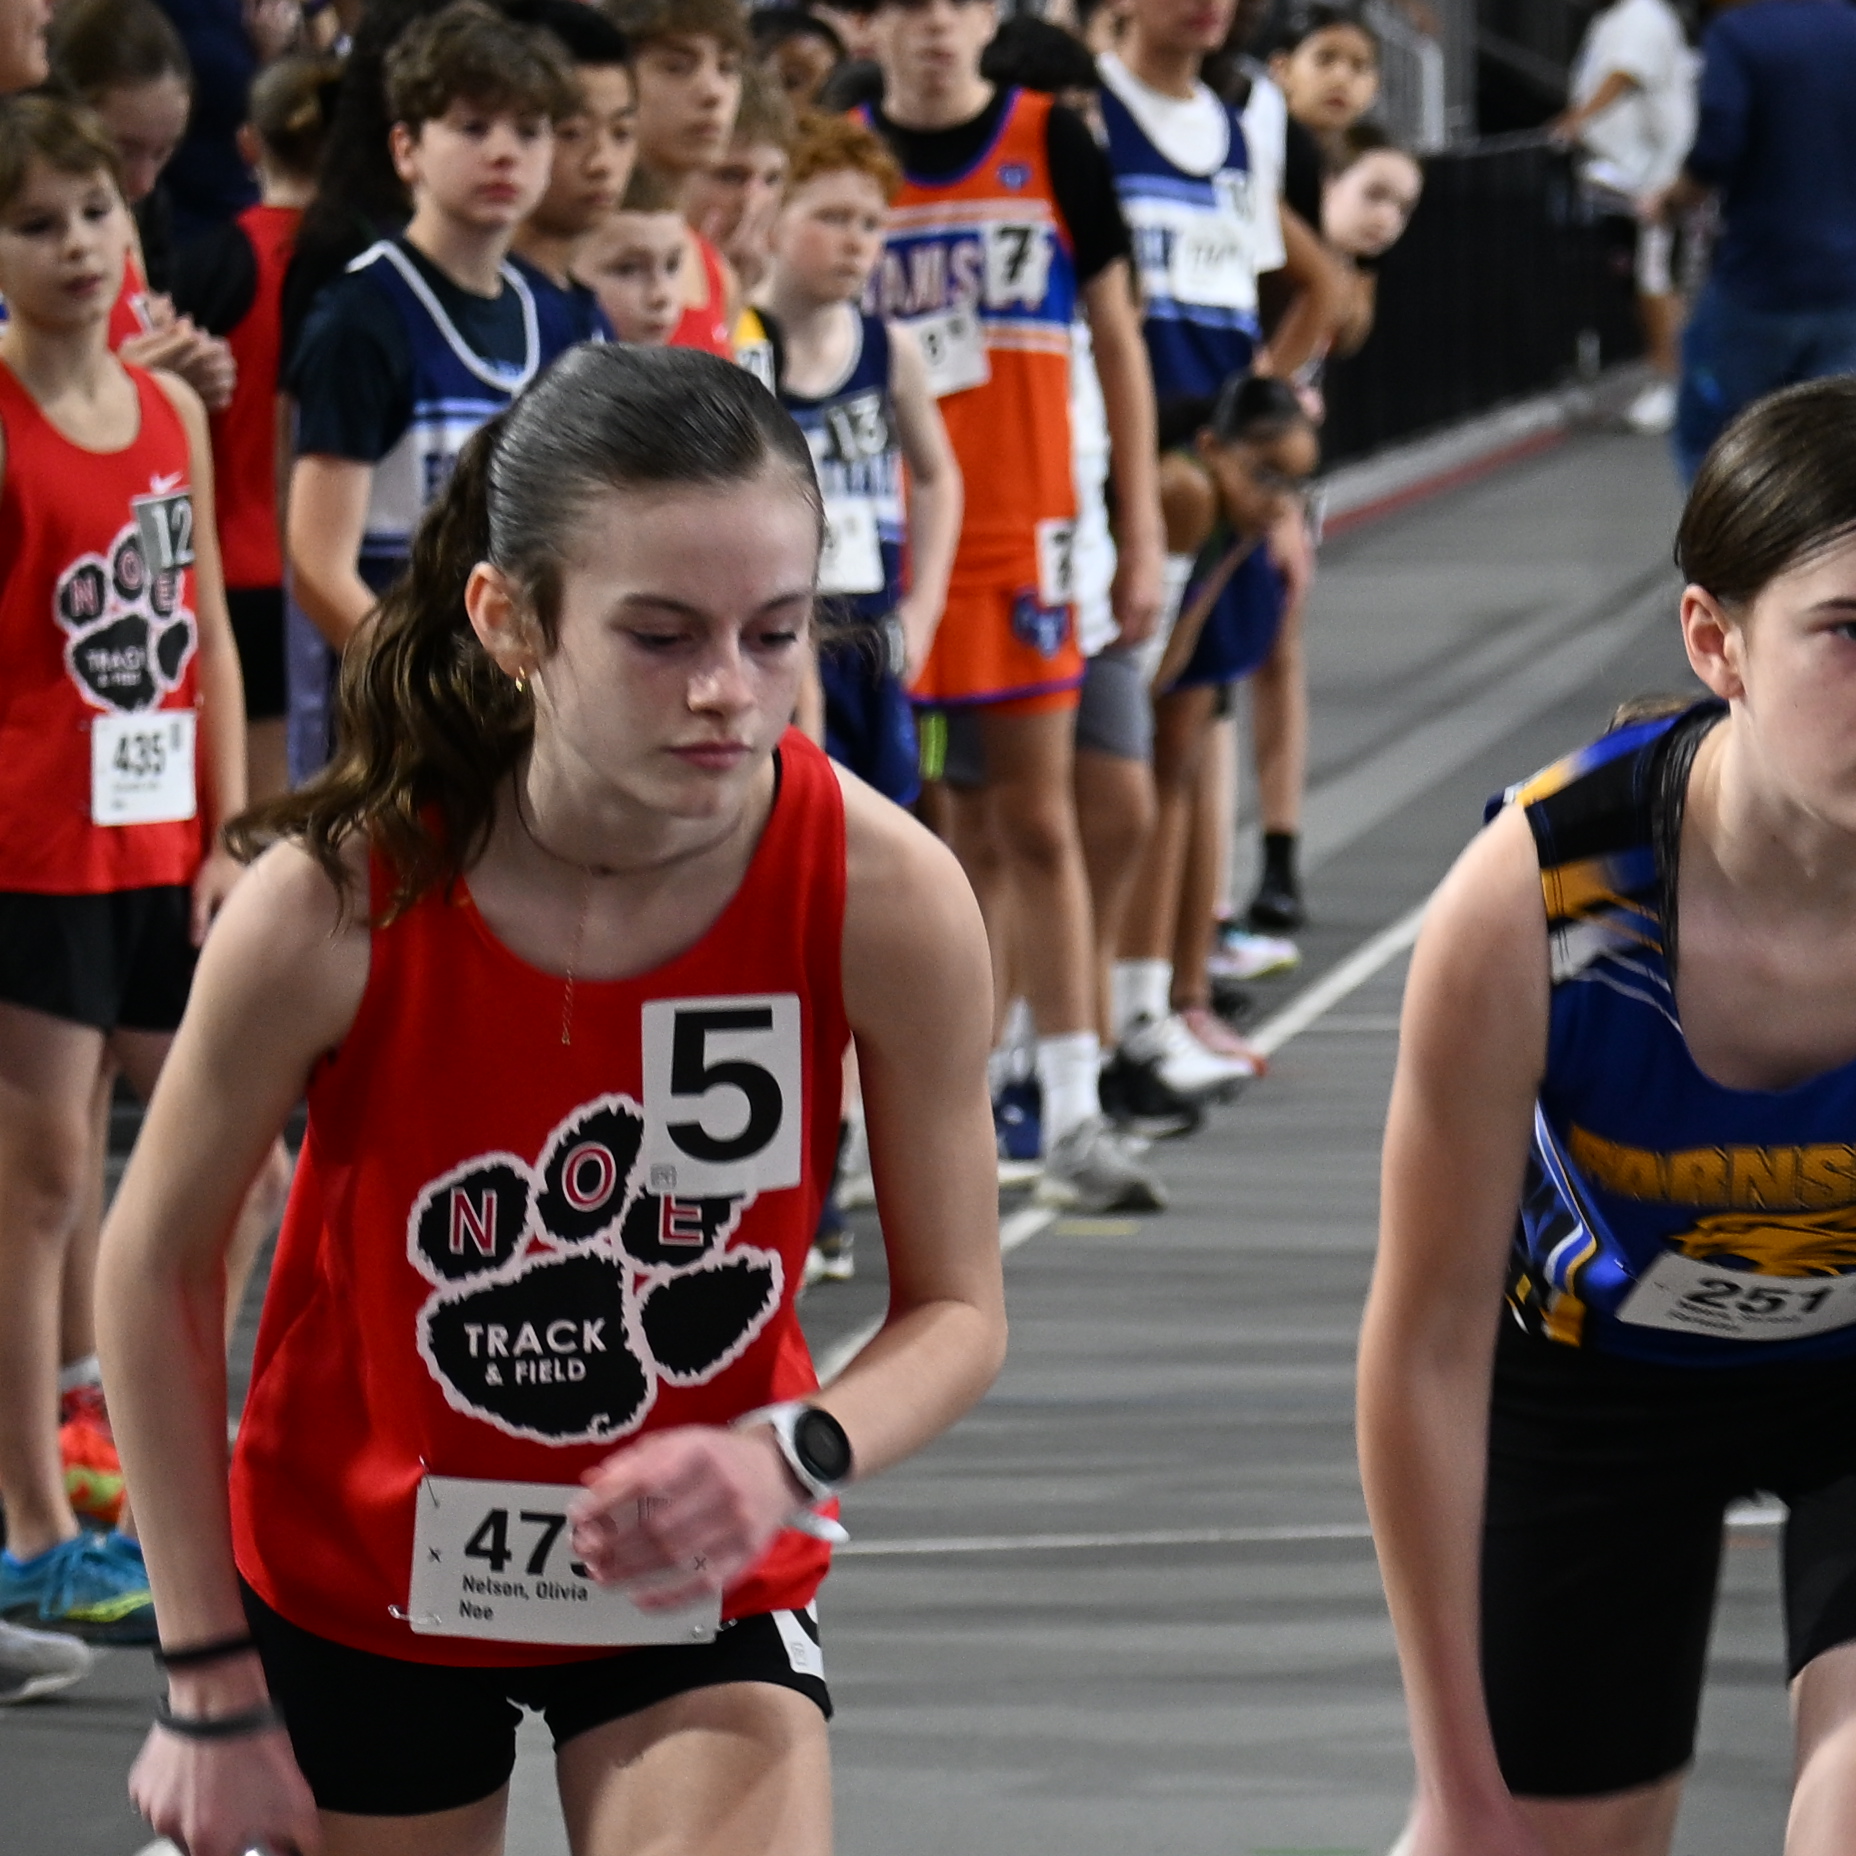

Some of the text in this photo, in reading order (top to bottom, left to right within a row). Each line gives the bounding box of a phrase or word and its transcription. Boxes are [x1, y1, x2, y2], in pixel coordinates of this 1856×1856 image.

[1000, 227, 1033, 282] 7
[827, 394, 888, 460] 13
[151, 500, 195, 568] 12
[113, 732, 167, 778] 435
[665, 1006, 784, 1163] 5
[448, 1141, 705, 1257] NOE
[1681, 1276, 1834, 1317] 251
[463, 1316, 608, 1358] TRACK
[484, 1357, 587, 1386] & FIELD
[464, 1508, 596, 1581] 47
[461, 1573, 589, 1603] Nelson, Olivia
